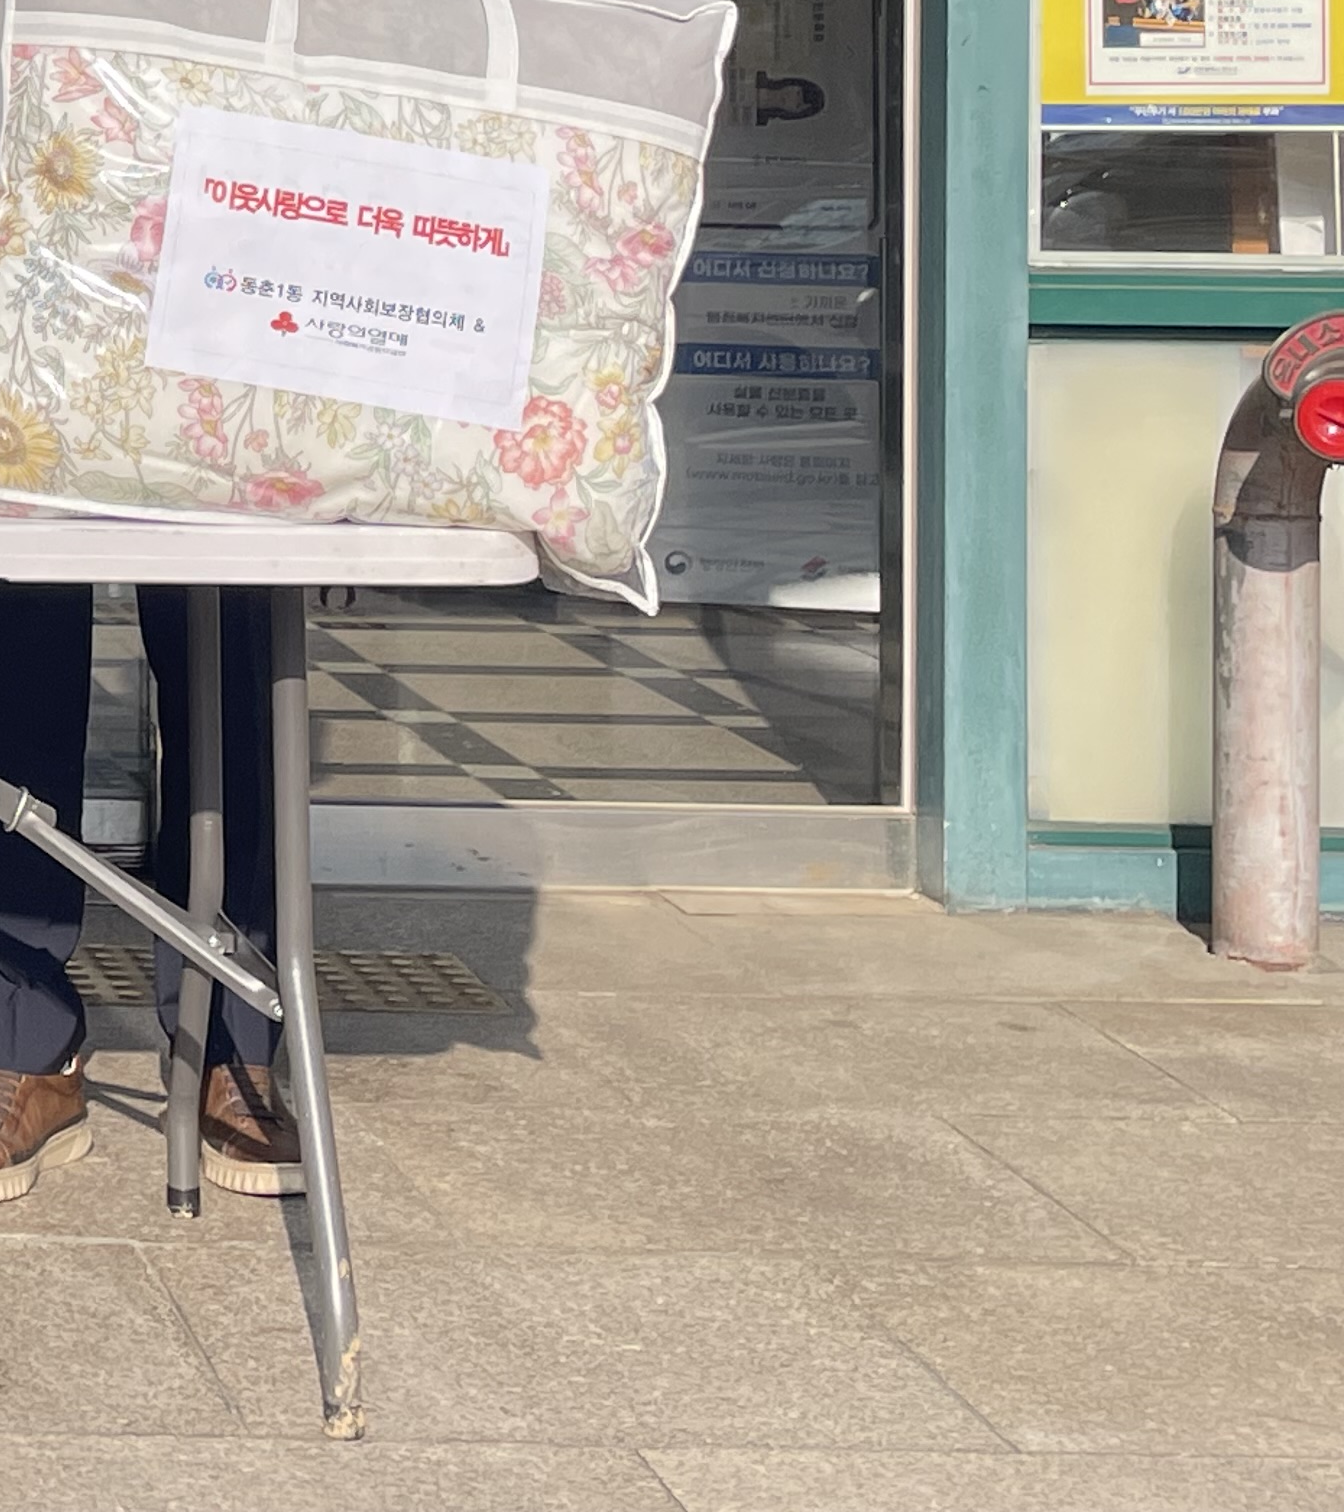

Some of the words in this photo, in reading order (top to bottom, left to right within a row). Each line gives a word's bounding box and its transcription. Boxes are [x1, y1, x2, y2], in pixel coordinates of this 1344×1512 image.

[357, 205, 405, 239] 더욱
[240, 276, 303, 304] 동춘1동
[312, 289, 466, 332] 지역사회보장협의체
[473, 317, 485, 333] &
[304, 317, 409, 347] 사랑의열매
[692, 351, 752, 369] 어디서
